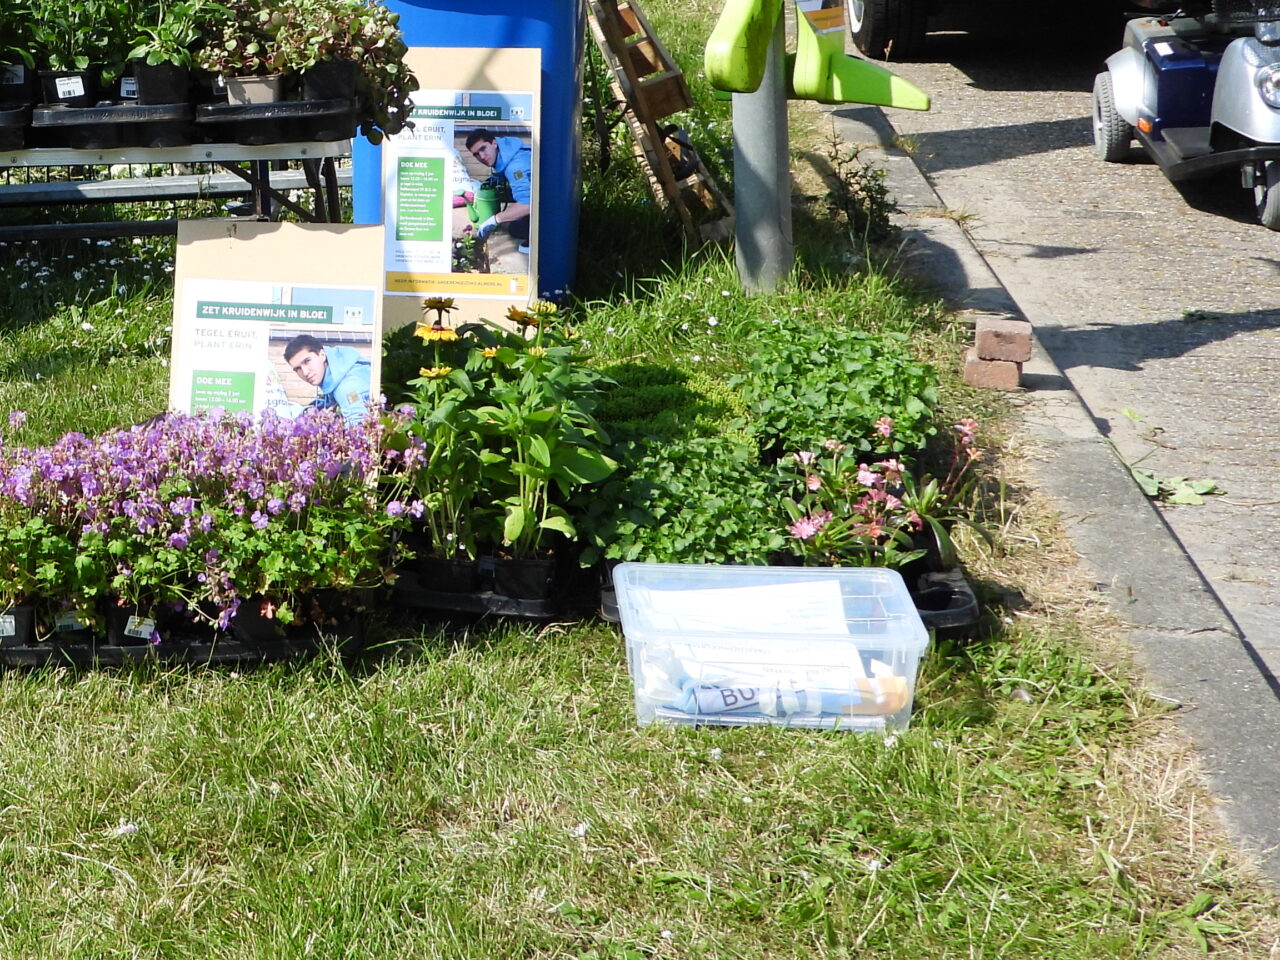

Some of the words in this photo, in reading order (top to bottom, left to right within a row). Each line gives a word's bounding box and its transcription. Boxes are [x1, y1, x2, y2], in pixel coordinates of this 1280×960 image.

[417, 108, 466, 116] KRUIDENWIJK
[467, 109, 475, 117] IN
[476, 109, 497, 117] BLOEI
[414, 161, 428, 169] MEE
[202, 305, 220, 315] ZET
[222, 306, 286, 318] KRUIDENWIJK
[288, 311, 298, 319] IN
[300, 311, 327, 319] BLOEI
[195, 328, 224, 338] TEGEL
[227, 330, 258, 340] ERUIT,
[194, 340, 226, 349] PLANT
[228, 341, 253, 350] ERIN
[196, 376, 214, 385] DOE
[215, 377, 233, 386] MEE
